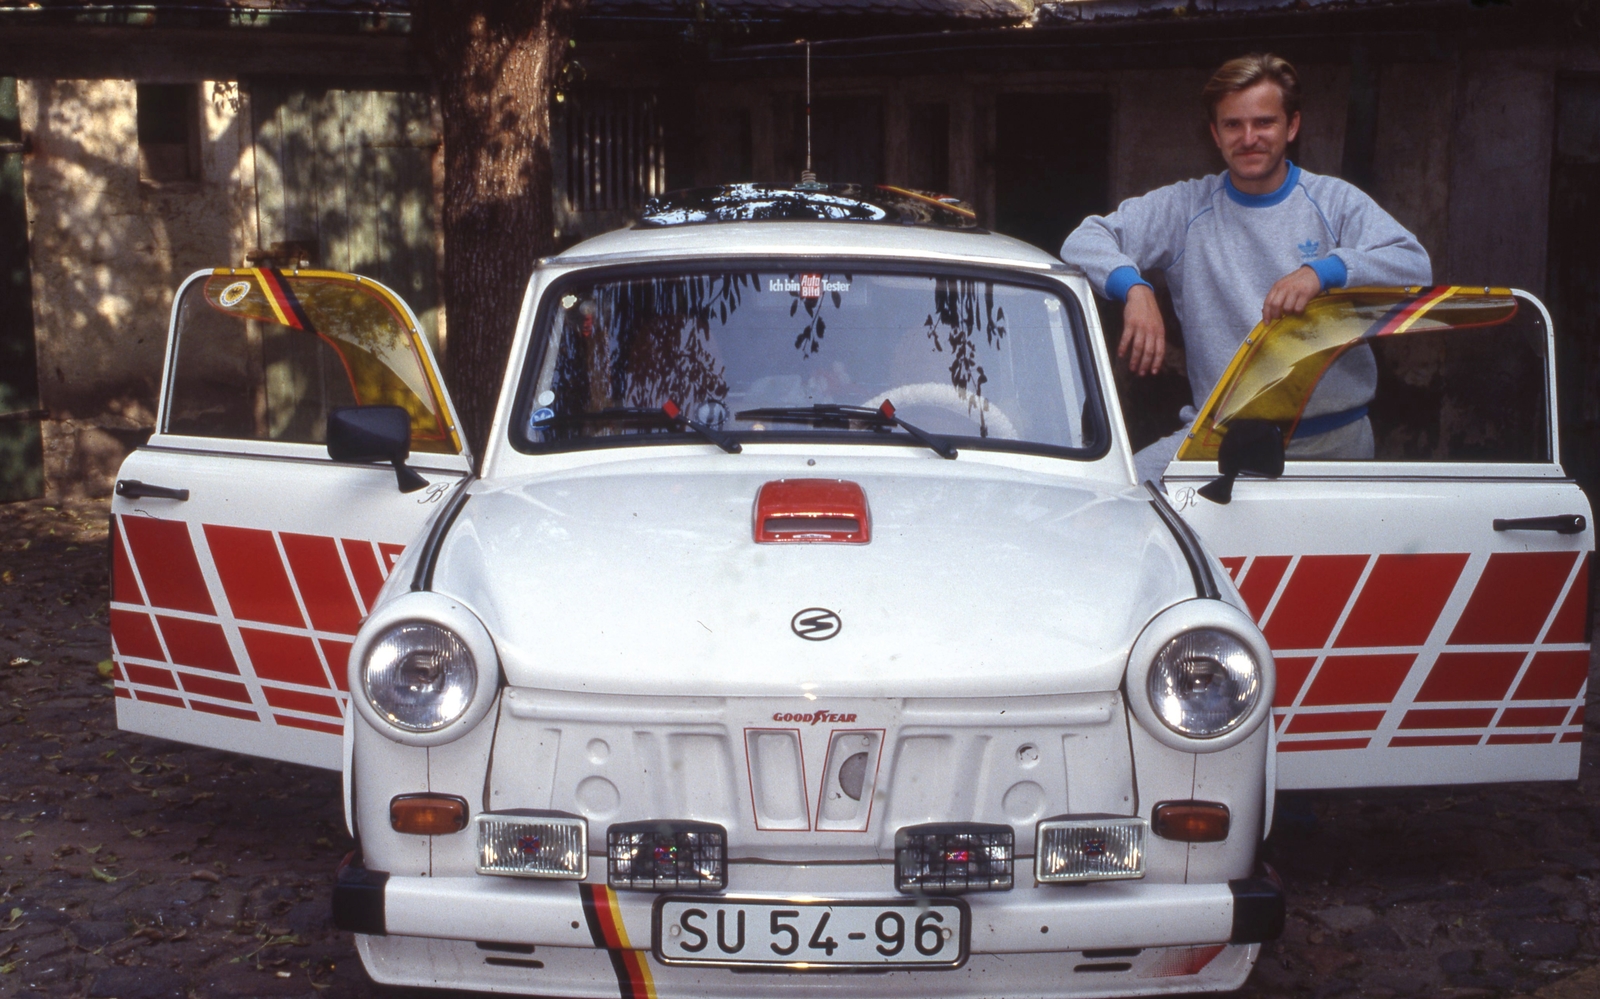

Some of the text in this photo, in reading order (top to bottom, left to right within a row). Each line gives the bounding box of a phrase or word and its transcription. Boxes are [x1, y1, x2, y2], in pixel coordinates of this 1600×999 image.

[769, 274, 851, 297] Ich bin Auto Bild Tester
[772, 710, 857, 726] GOODYEAR
[679, 908, 945, 956] SU 54-96
